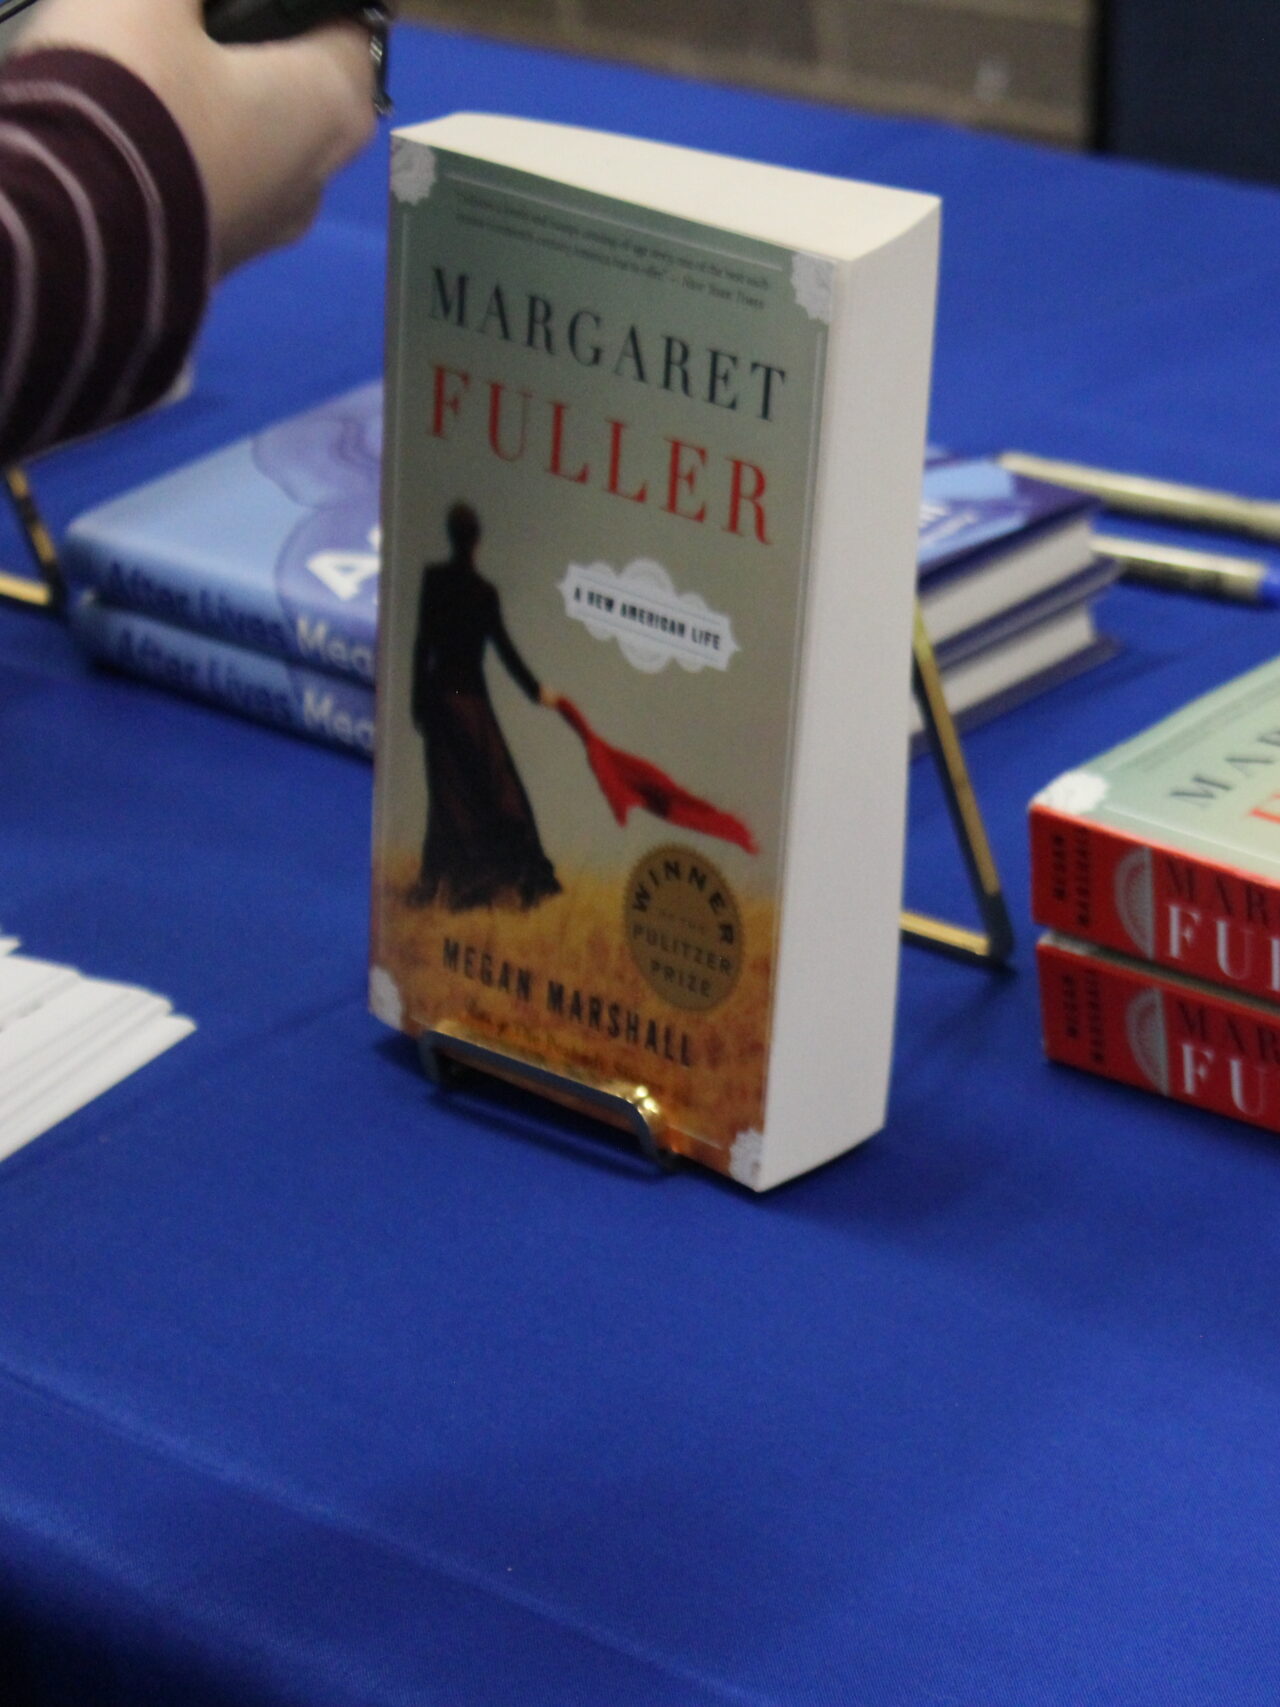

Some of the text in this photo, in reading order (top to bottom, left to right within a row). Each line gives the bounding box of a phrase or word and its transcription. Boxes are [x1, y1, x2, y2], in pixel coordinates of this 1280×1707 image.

[429, 267, 787, 422] MARGARET
[429, 363, 773, 545] FULLER
[574, 587, 721, 650] A NEW AMERICAN LIFE
[632, 858, 735, 946] WINNER
[631, 923, 733, 977] PULITZER
[650, 959, 712, 999] PRIZE
[442, 938, 532, 1001] MEGAN
[547, 979, 695, 1068] MARSHALL
